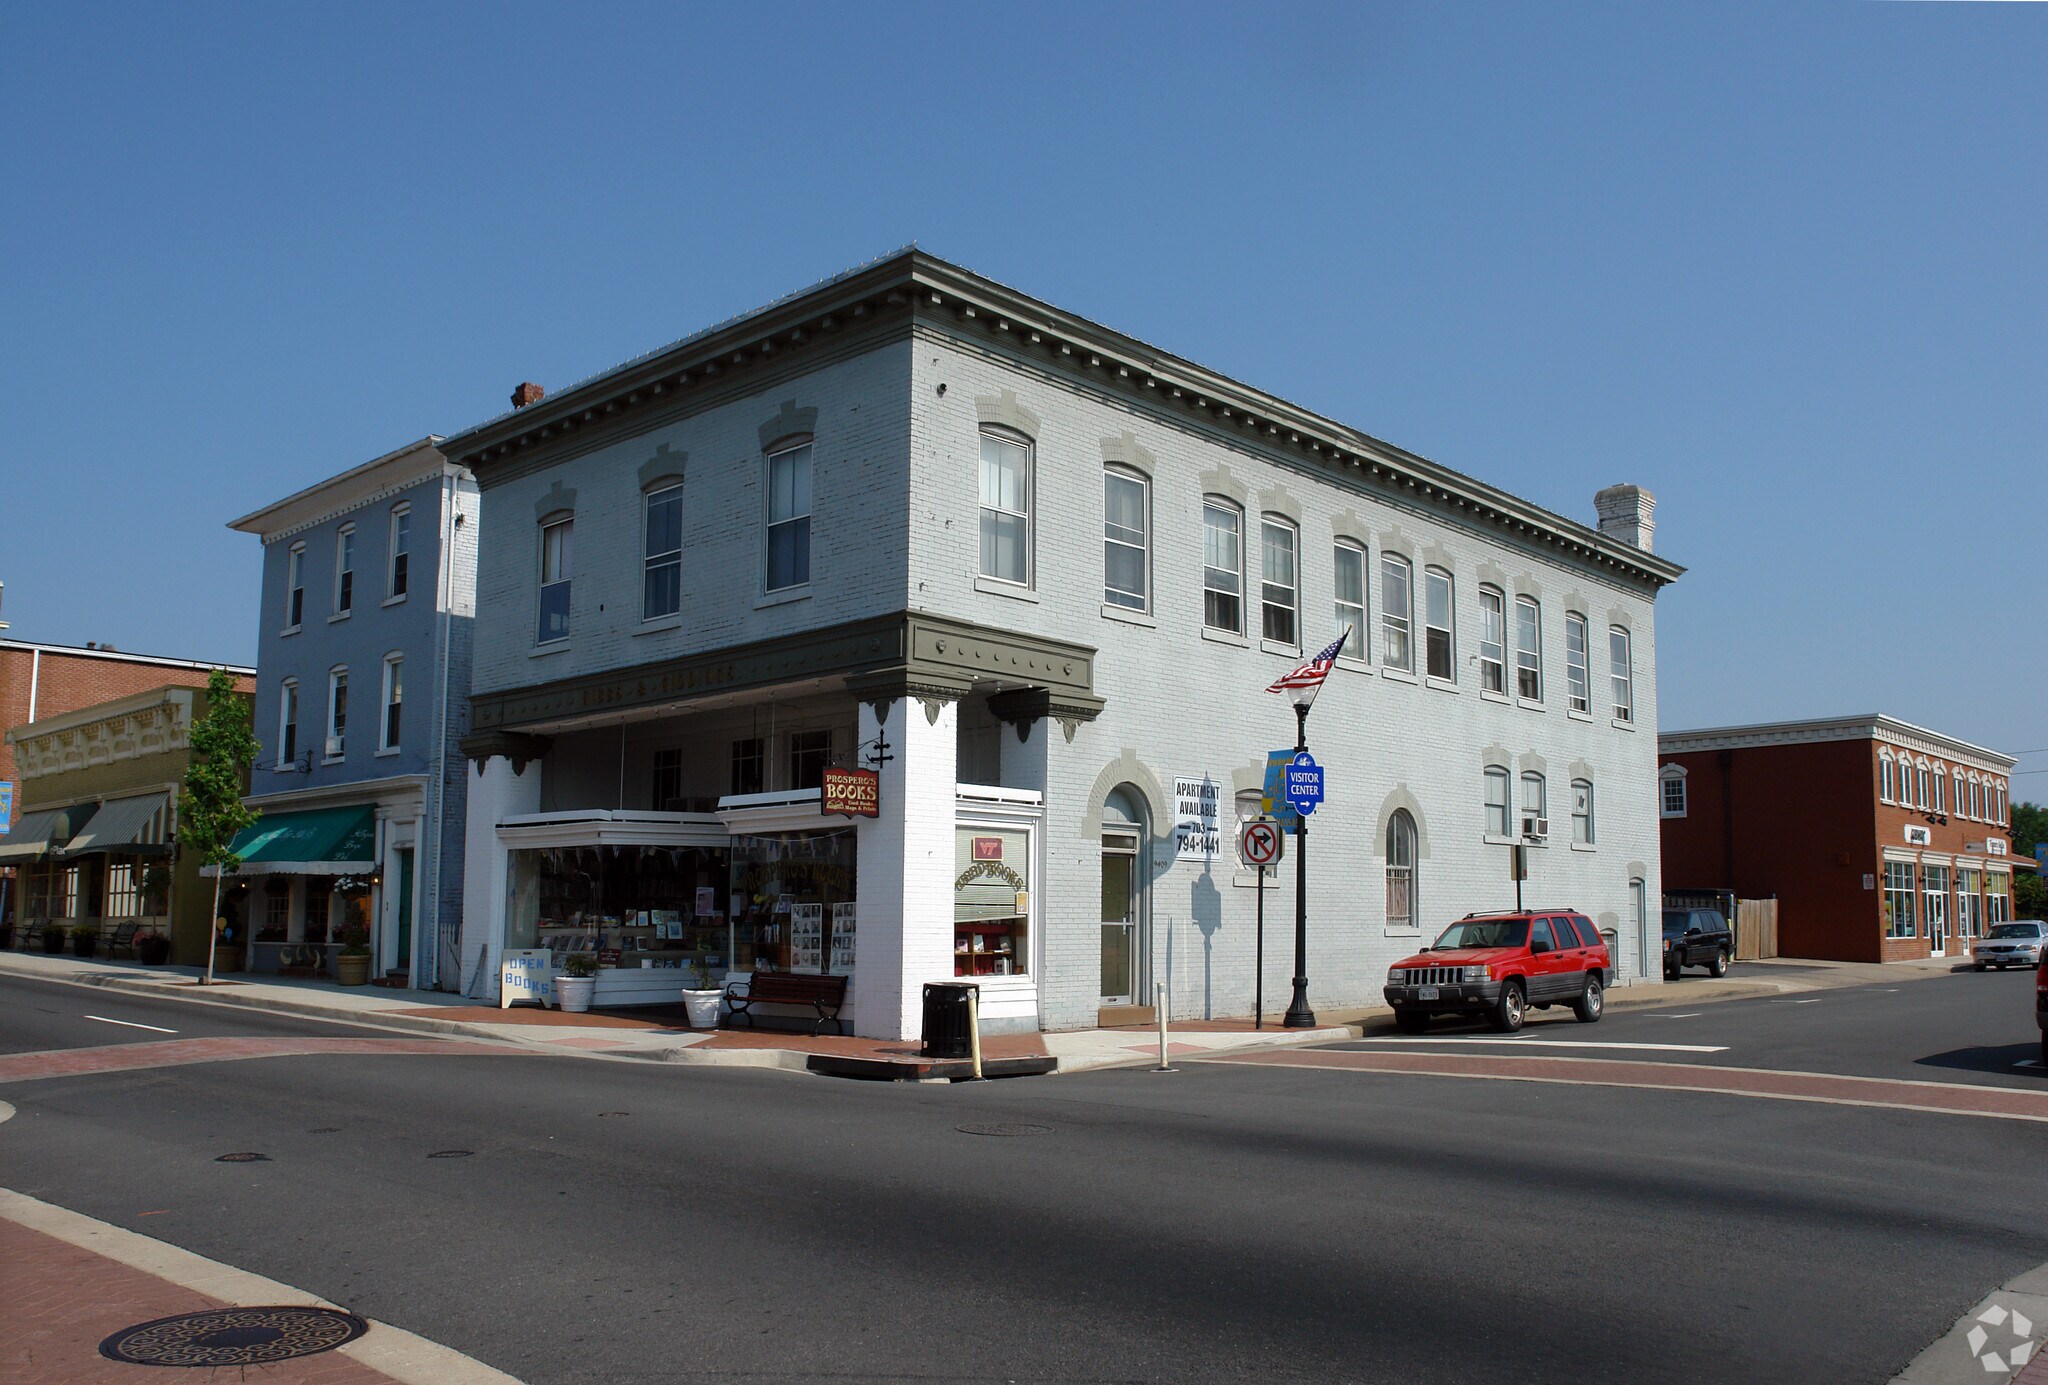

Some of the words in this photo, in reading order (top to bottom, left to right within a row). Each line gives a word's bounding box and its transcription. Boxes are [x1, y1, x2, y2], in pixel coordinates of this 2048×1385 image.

[826, 774, 877, 786] PROSPERO'S
[1290, 772, 1320, 783] VISITOR
[826, 783, 877, 801] BOOKS
[1176, 782, 1220, 800] APARTMENT
[1290, 784, 1319, 796] CENTER
[1179, 801, 1217, 818] AVAILABLE
[1192, 822, 1206, 835] 703
[980, 842, 998, 856] VT
[1177, 834, 1220, 854] 794-1441
[985, 862, 1024, 892] BOOKS
[510, 958, 545, 970] OPEN
[505, 972, 549, 994] BOOKS
